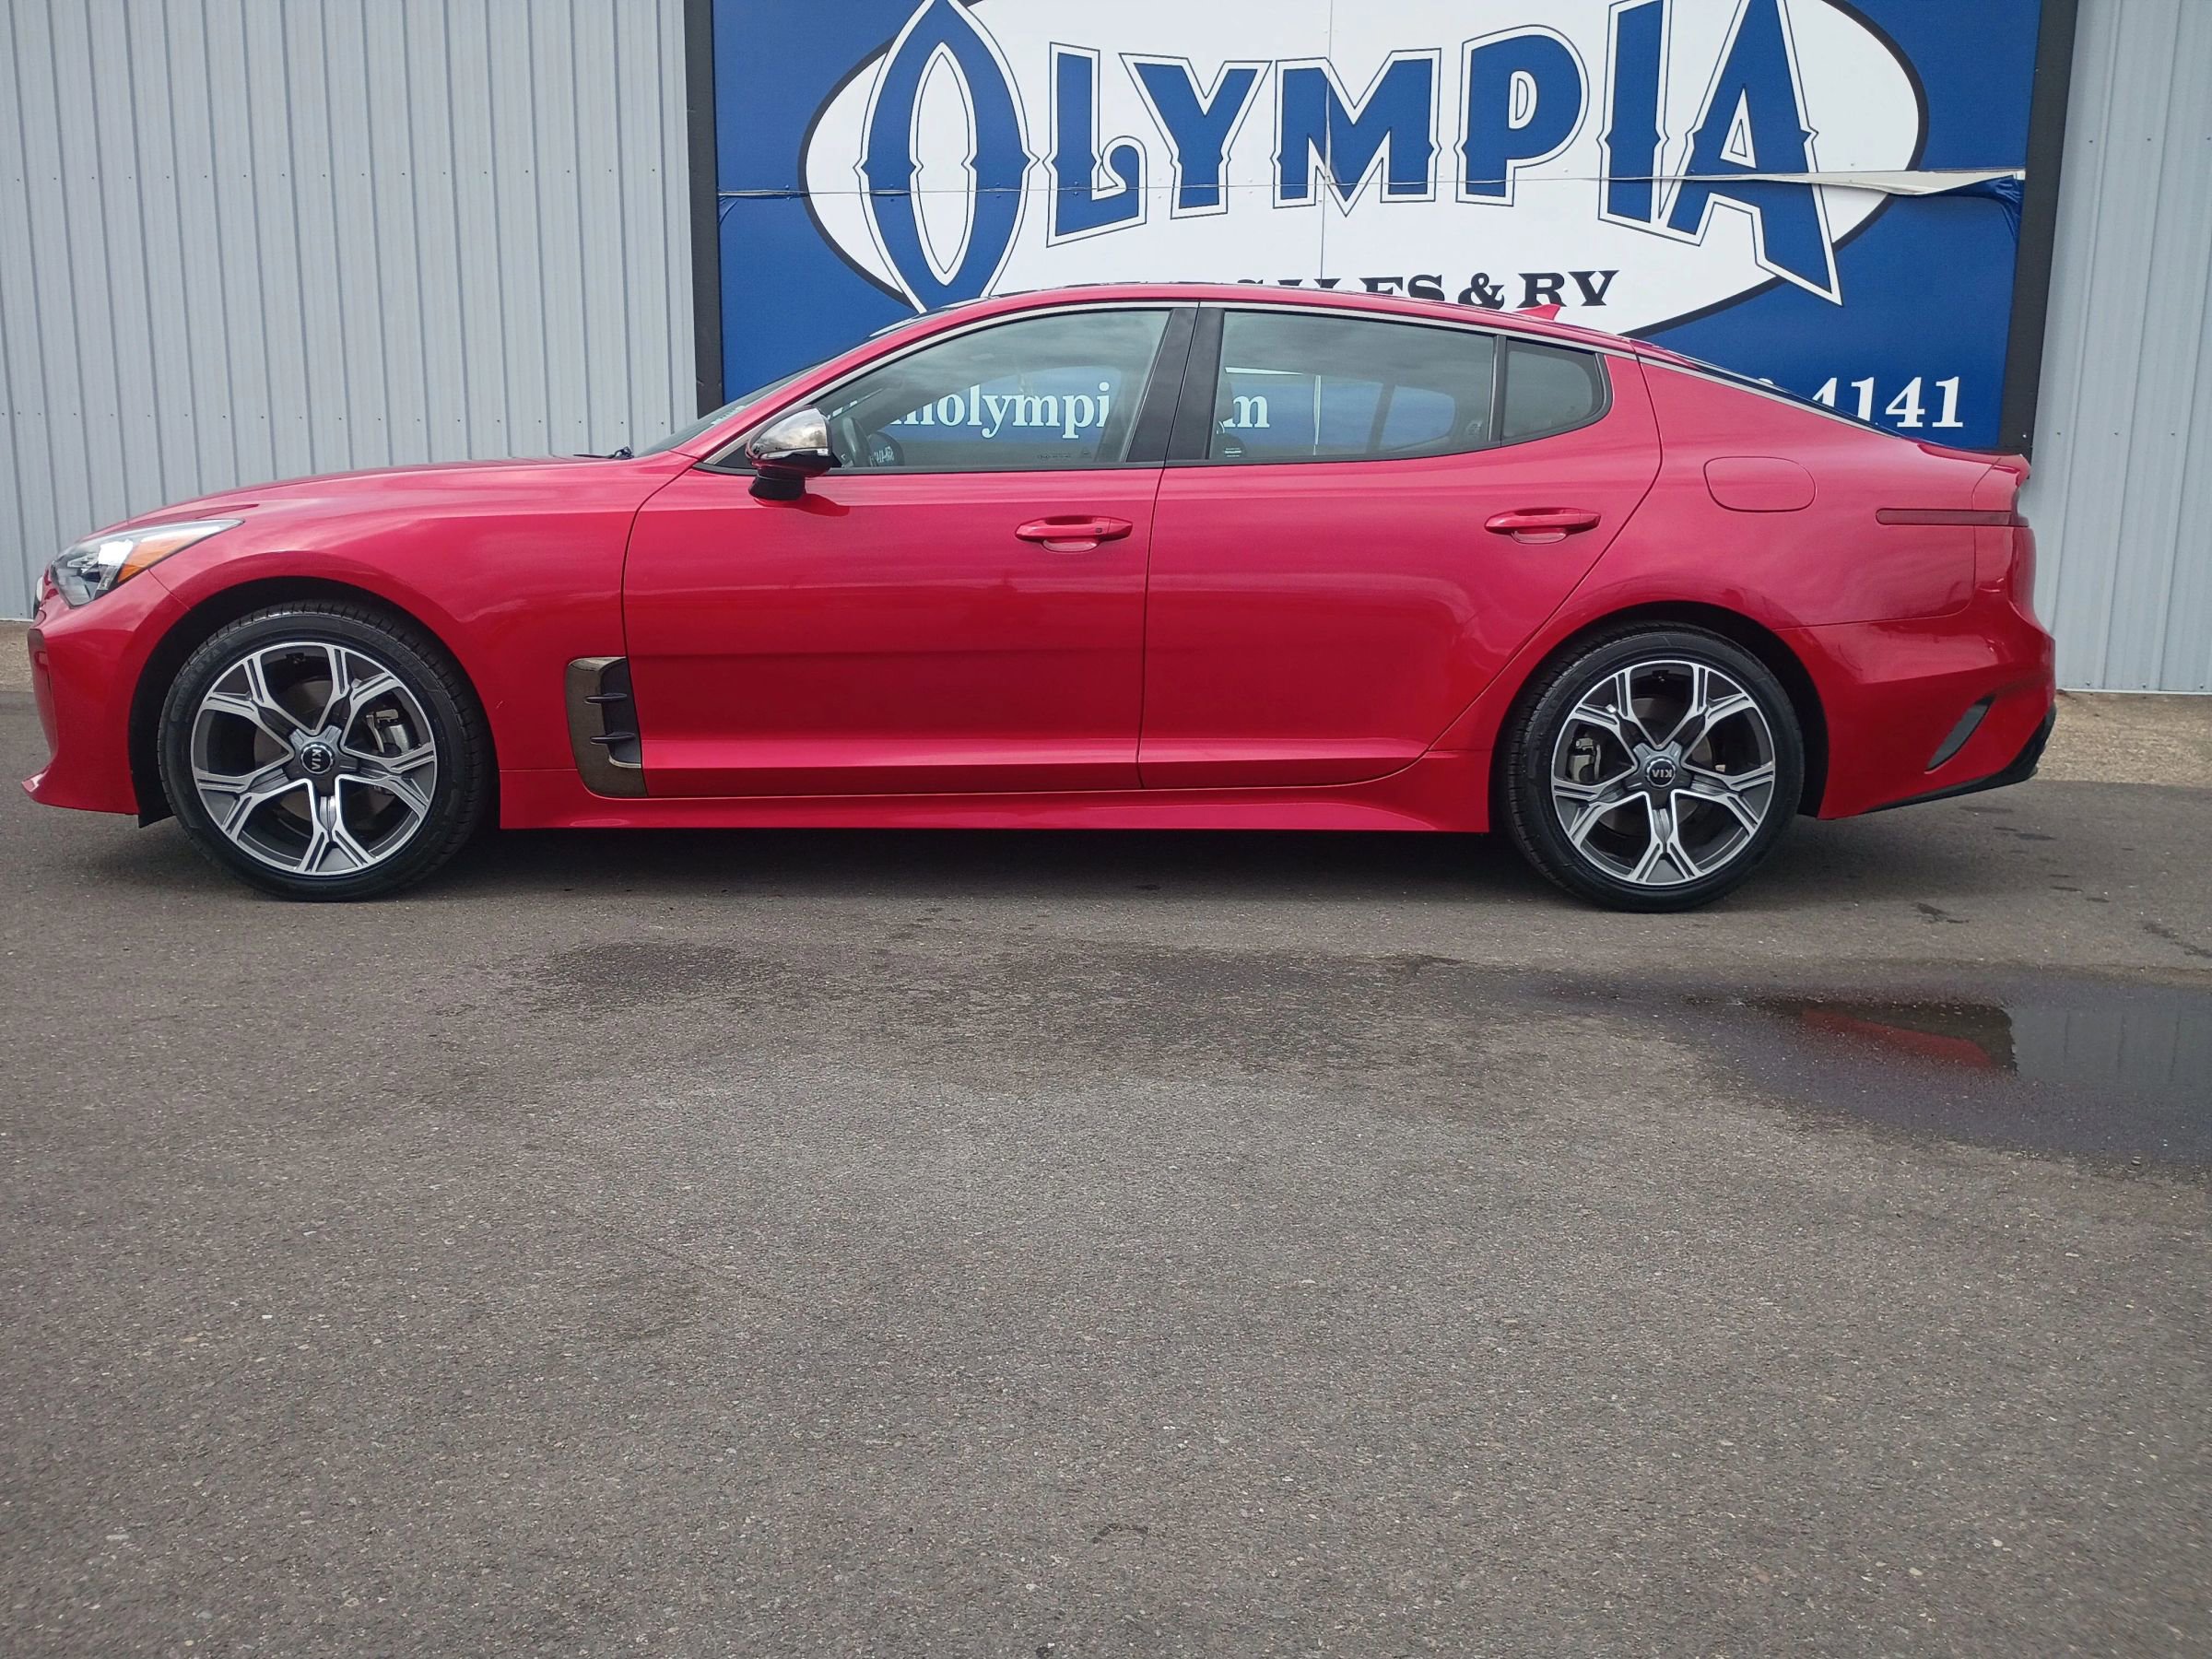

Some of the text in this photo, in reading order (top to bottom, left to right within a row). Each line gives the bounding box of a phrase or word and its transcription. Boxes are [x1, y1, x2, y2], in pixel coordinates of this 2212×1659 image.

[855, 0, 1842, 312] OLYMPIA
[1457, 272, 1504, 308] &
[1518, 270, 1620, 306] RV
[312, 748, 322, 770] KIA
[1652, 769, 1673, 778] KIA
